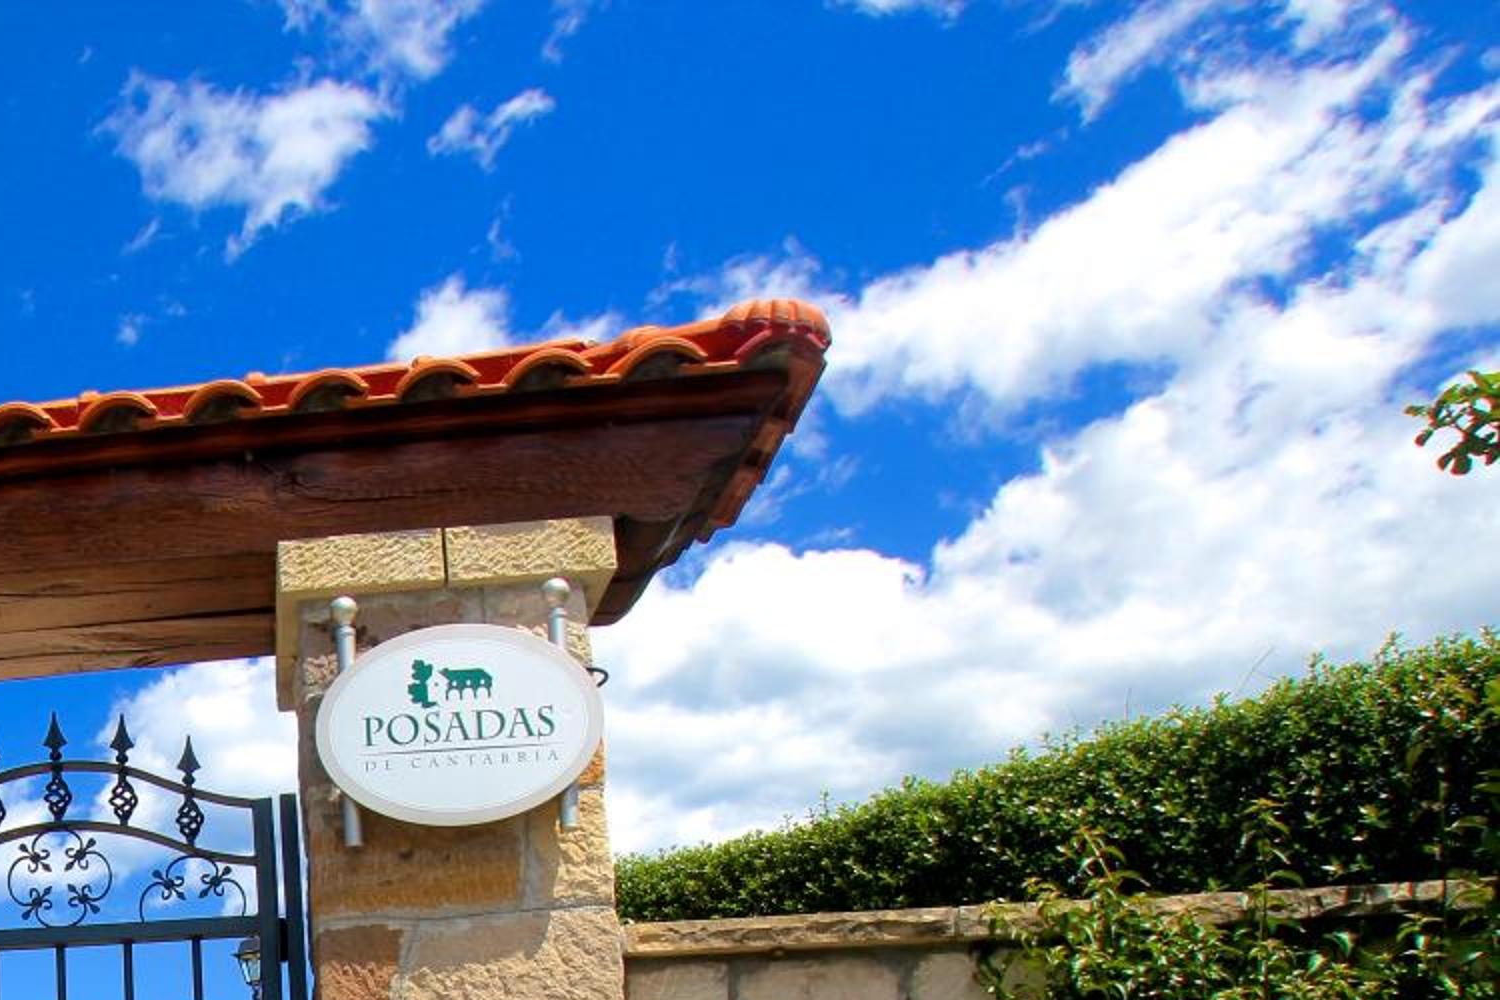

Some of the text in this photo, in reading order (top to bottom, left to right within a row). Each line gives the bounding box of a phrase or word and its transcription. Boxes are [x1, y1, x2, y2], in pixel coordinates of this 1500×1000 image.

[363, 704, 556, 747] POSADAS
[364, 750, 559, 773] DE CANTABRIA
